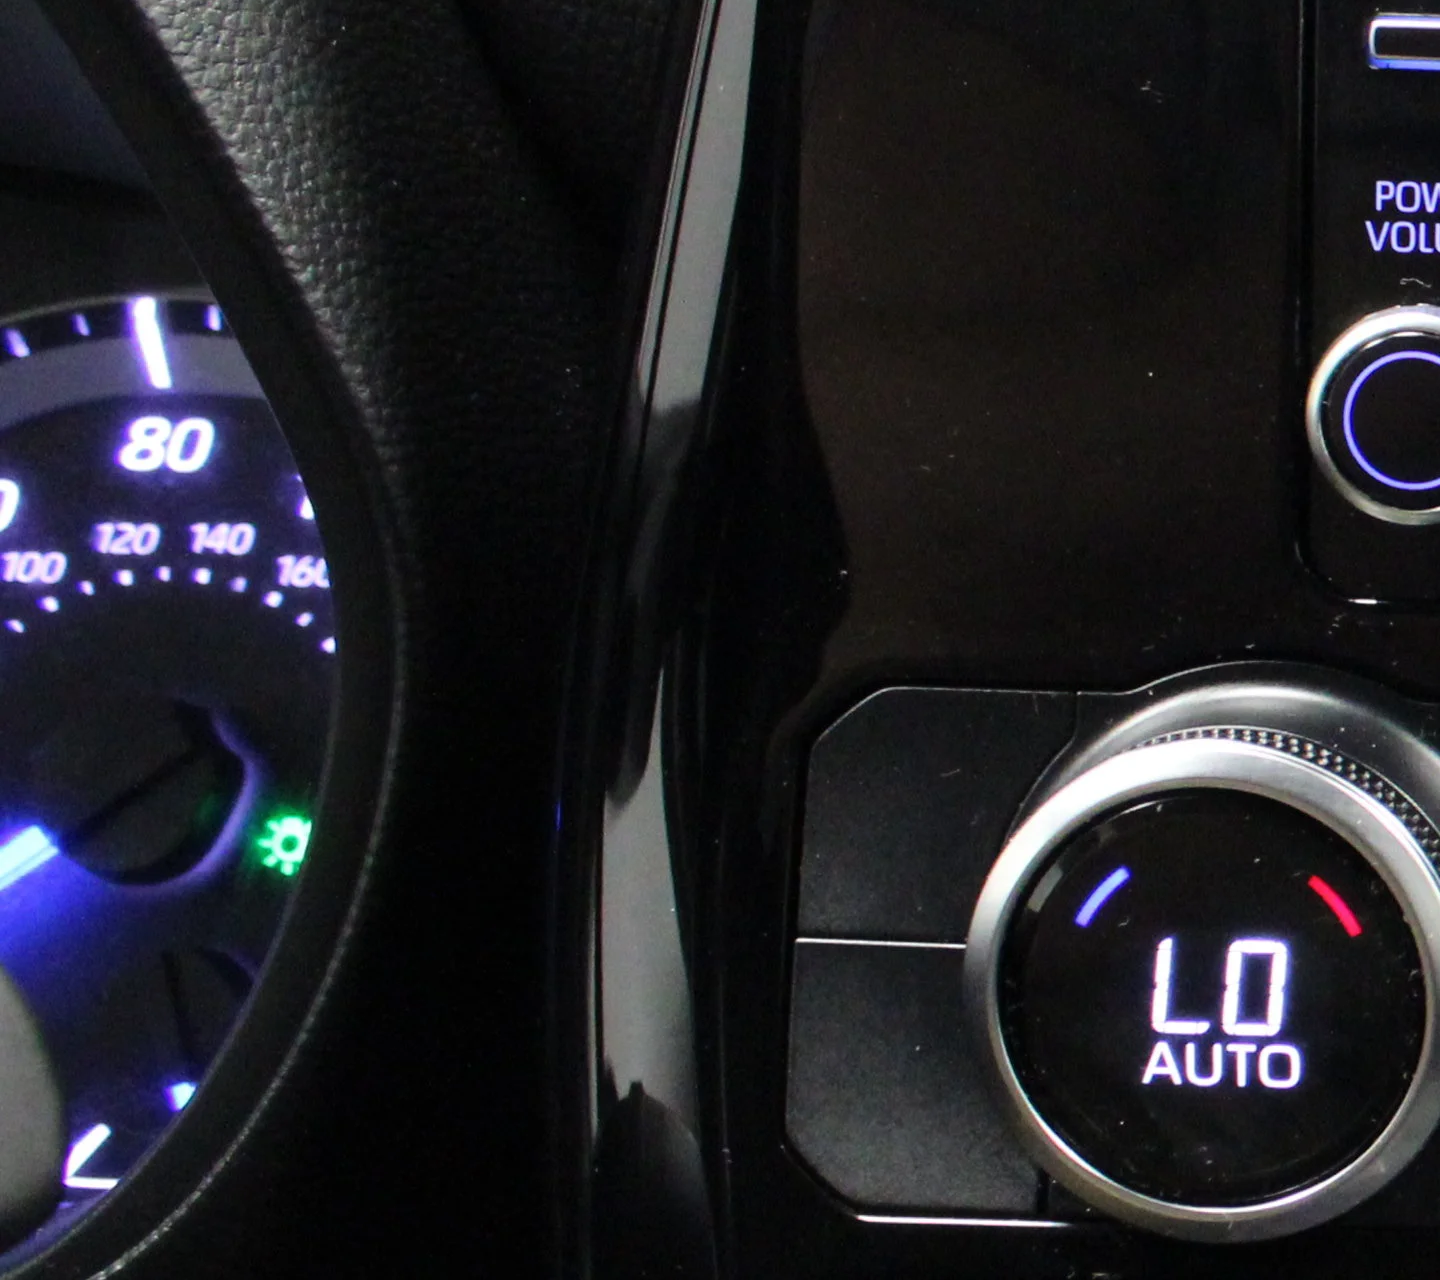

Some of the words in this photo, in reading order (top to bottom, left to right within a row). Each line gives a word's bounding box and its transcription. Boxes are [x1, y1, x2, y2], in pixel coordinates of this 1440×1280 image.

[116, 414, 215, 473] 80
[0, 550, 67, 585] 100
[93, 522, 161, 556] 120
[188, 522, 256, 556] 140
[1150, 934, 1292, 1036] LO
[1141, 1041, 1304, 1090] AUTO
